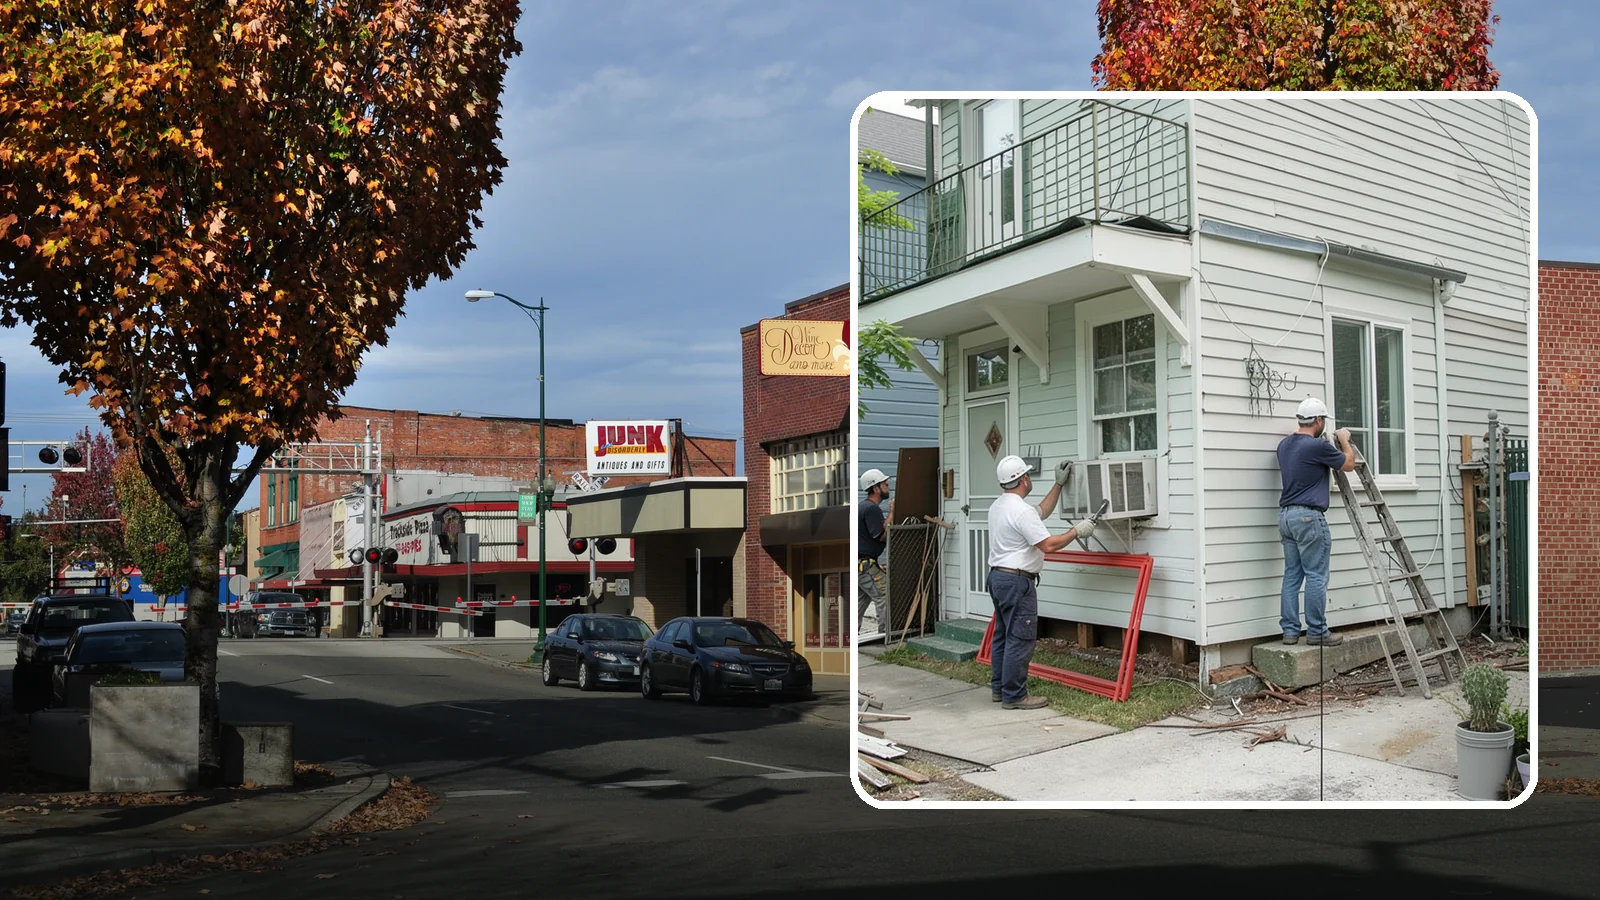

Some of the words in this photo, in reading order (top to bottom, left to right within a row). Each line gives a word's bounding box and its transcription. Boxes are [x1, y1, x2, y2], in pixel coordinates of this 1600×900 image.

[765, 328, 831, 365] Decor
[595, 425, 664, 457] JUNK
[608, 446, 646, 454] DISORDERLY
[597, 461, 628, 470] ANTIQUES
[631, 461, 644, 470] AND
[647, 461, 665, 470] GIFTS
[390, 521, 413, 540] Trackside
[414, 519, 429, 535] Pizza
